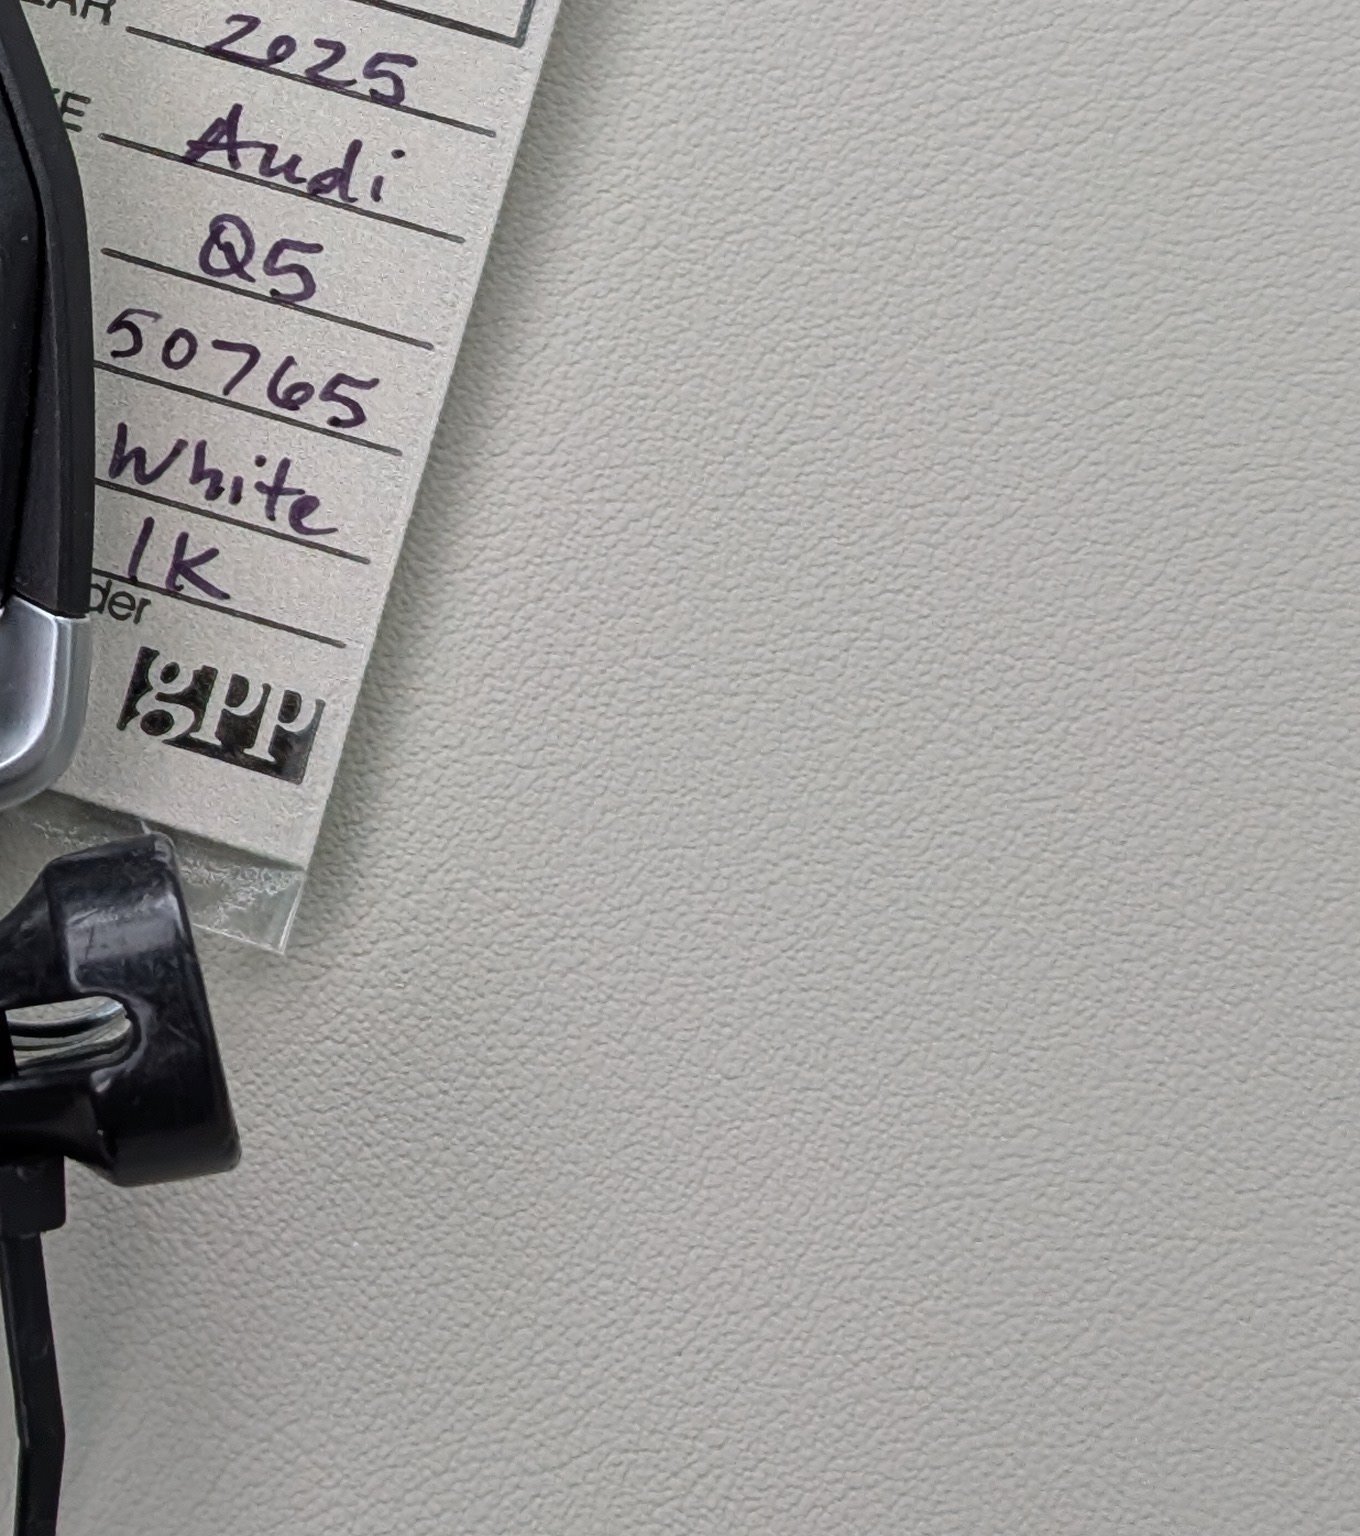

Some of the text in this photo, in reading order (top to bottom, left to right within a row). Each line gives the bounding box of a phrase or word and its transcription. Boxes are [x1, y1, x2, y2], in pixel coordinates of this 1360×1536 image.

[206, 13, 418, 105] 2025
[180, 103, 406, 202] Audi
[199, 214, 324, 303] Q5
[106, 309, 380, 428] 50765
[108, 423, 339, 536] White
